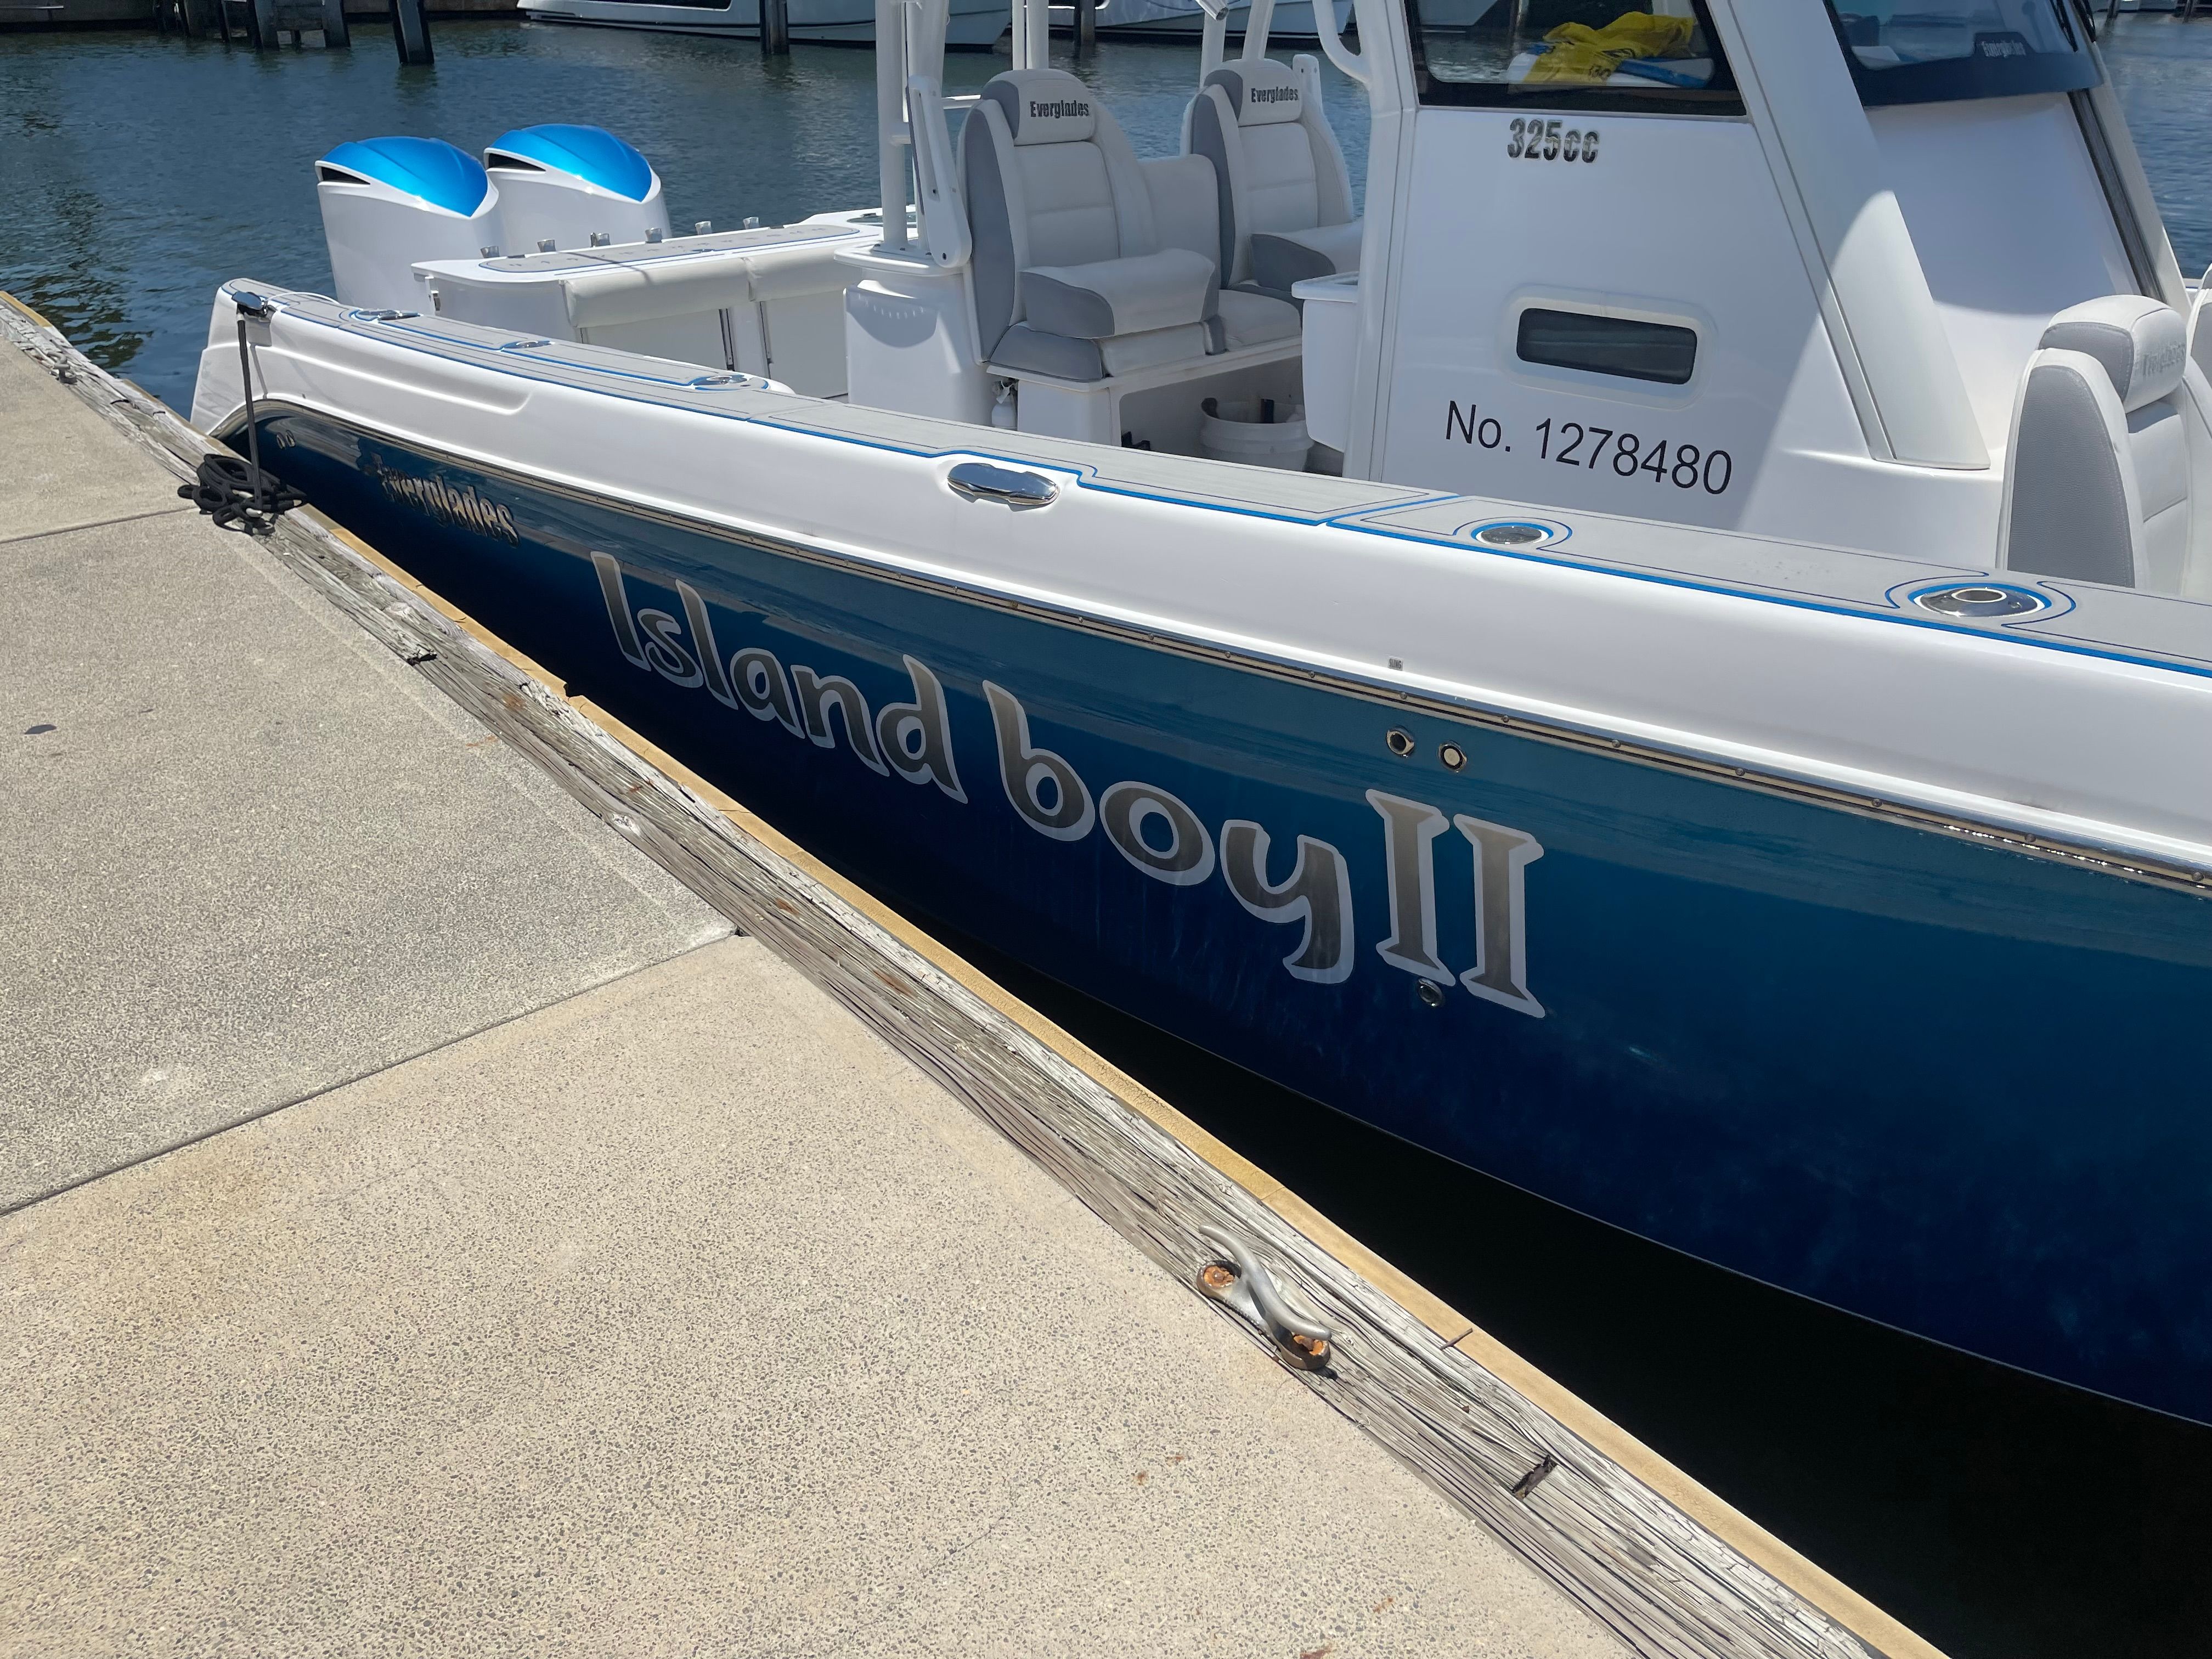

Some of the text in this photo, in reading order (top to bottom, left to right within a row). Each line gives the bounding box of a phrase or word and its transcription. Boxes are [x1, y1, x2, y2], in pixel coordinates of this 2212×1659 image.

[1251, 86, 1299, 104] Everglades
[1030, 99, 1089, 119] Everglades
[1445, 400, 1732, 495] No. 1278480
[1389, 658, 1402, 669] SLING
[590, 550, 968, 804] Island
[982, 679, 1355, 984] boy
